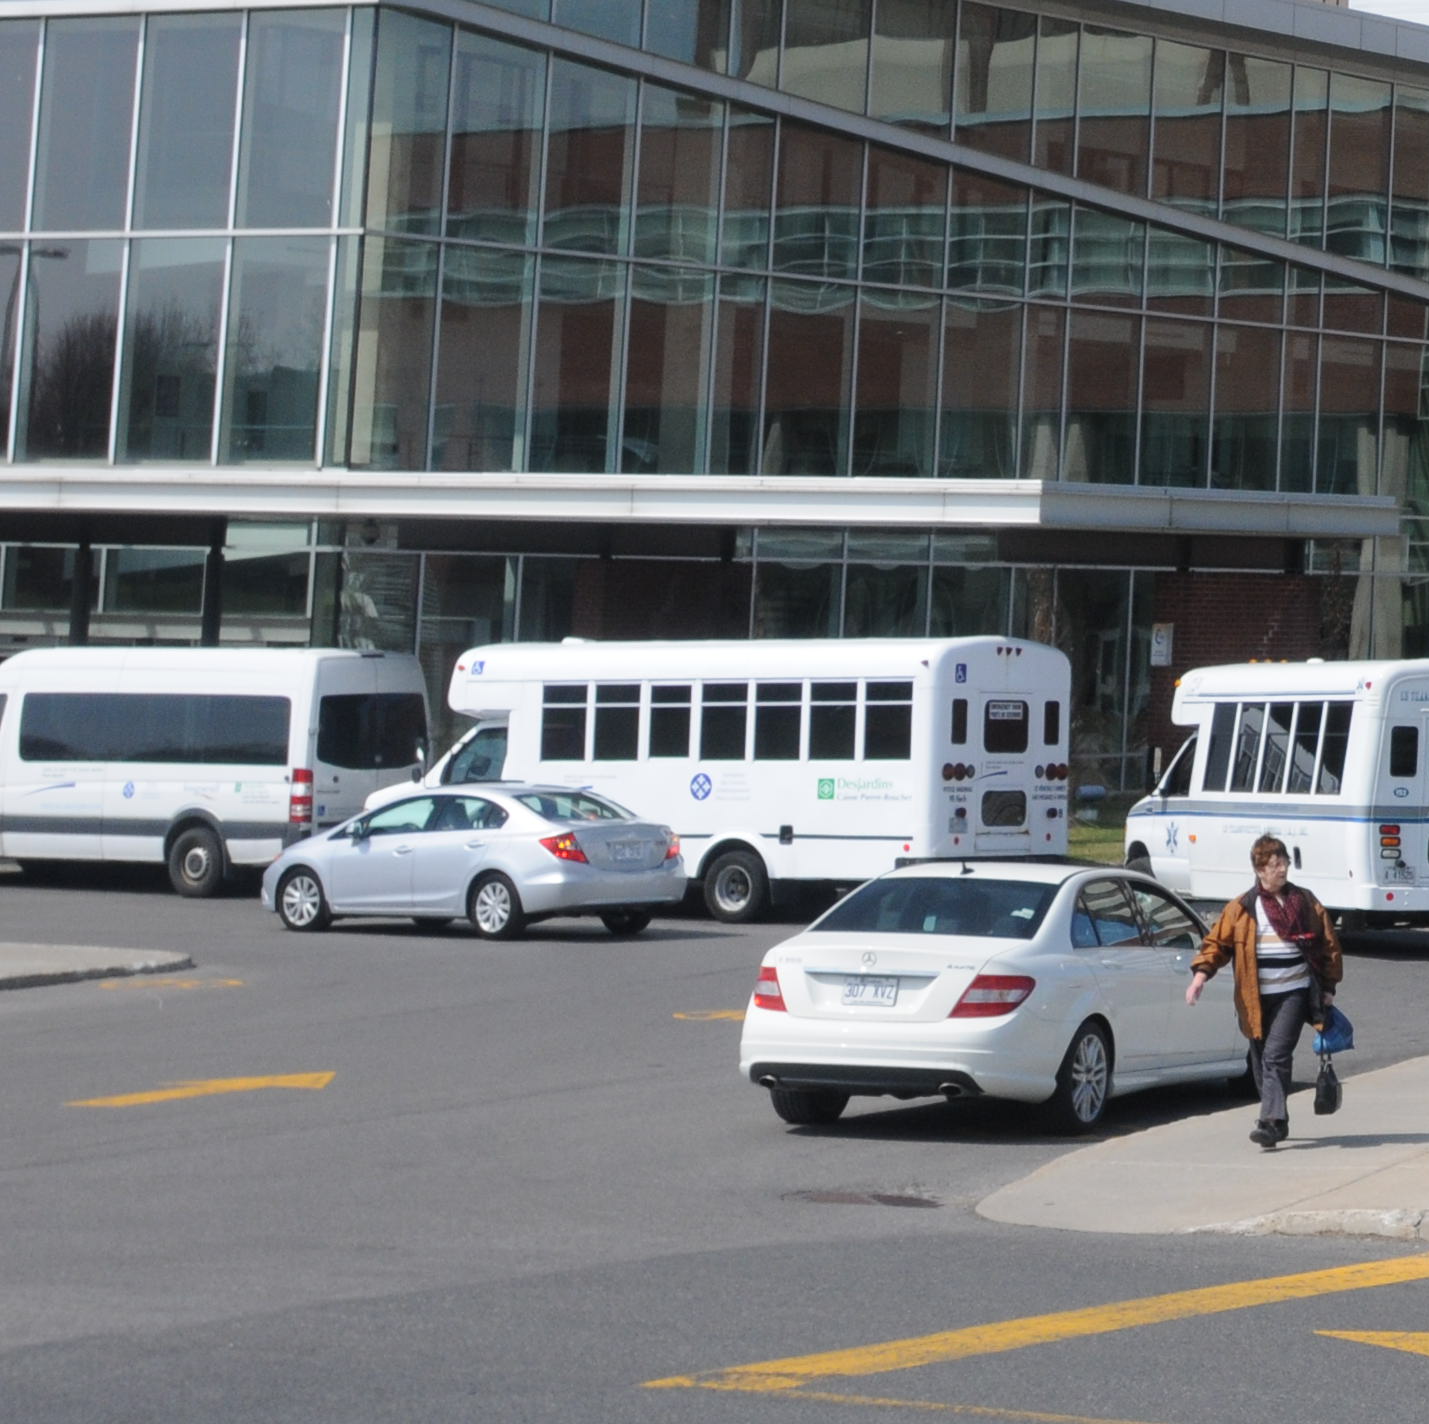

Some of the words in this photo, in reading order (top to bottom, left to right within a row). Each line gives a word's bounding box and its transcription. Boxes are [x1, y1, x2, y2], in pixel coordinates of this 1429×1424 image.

[837, 776, 894, 791] Desjardins
[844, 982, 865, 998] 307
[873, 983, 894, 1000] XVZ
